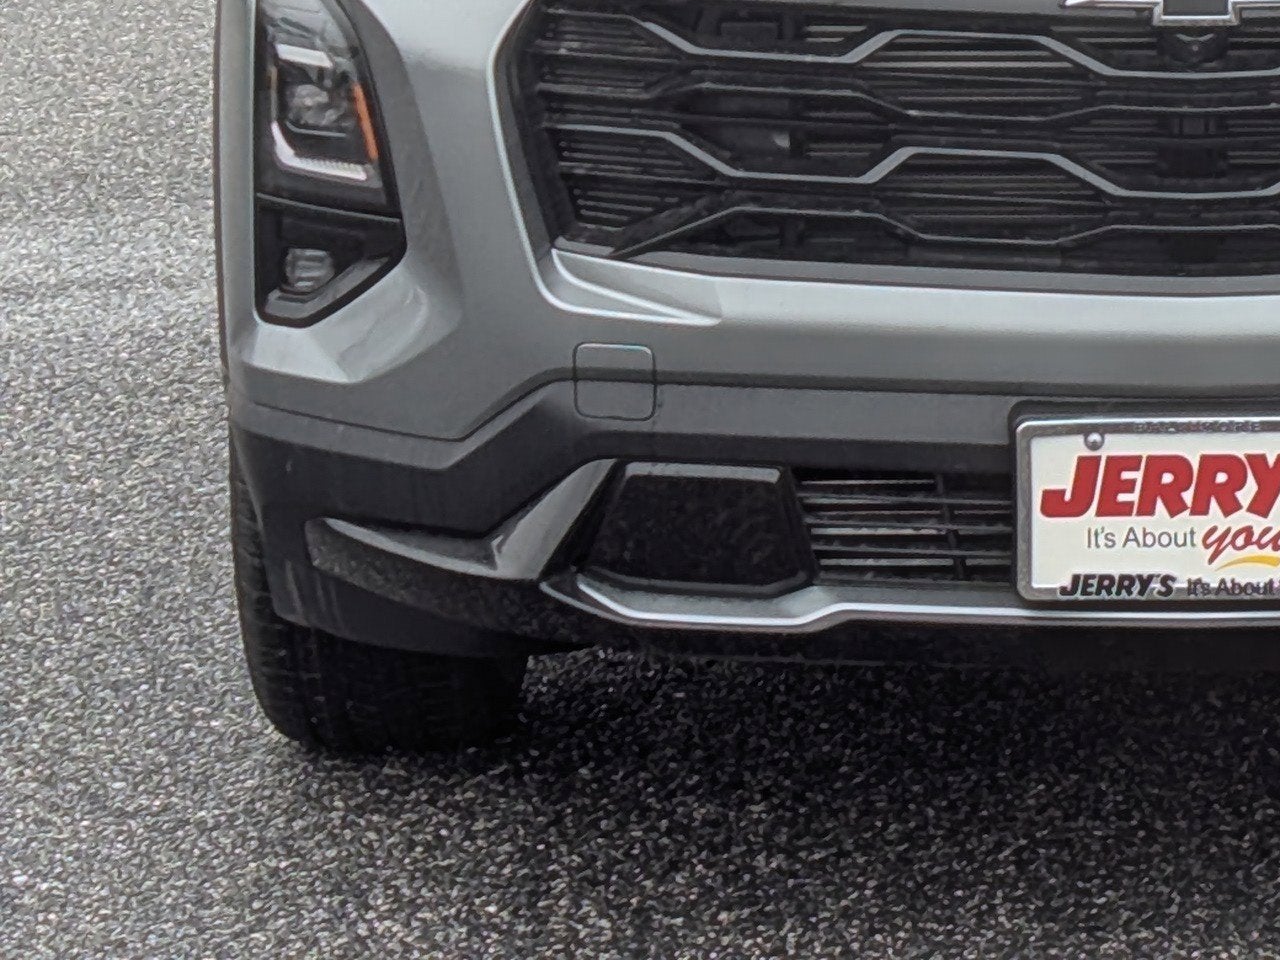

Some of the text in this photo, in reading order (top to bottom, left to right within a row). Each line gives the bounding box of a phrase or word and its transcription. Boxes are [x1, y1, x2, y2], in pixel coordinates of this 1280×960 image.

[1087, 528, 1116, 549] It's
[1122, 527, 1197, 549] About
[1059, 573, 1177, 597] JERRY'S
[1187, 577, 1211, 596] It's
[1213, 577, 1275, 596] About
